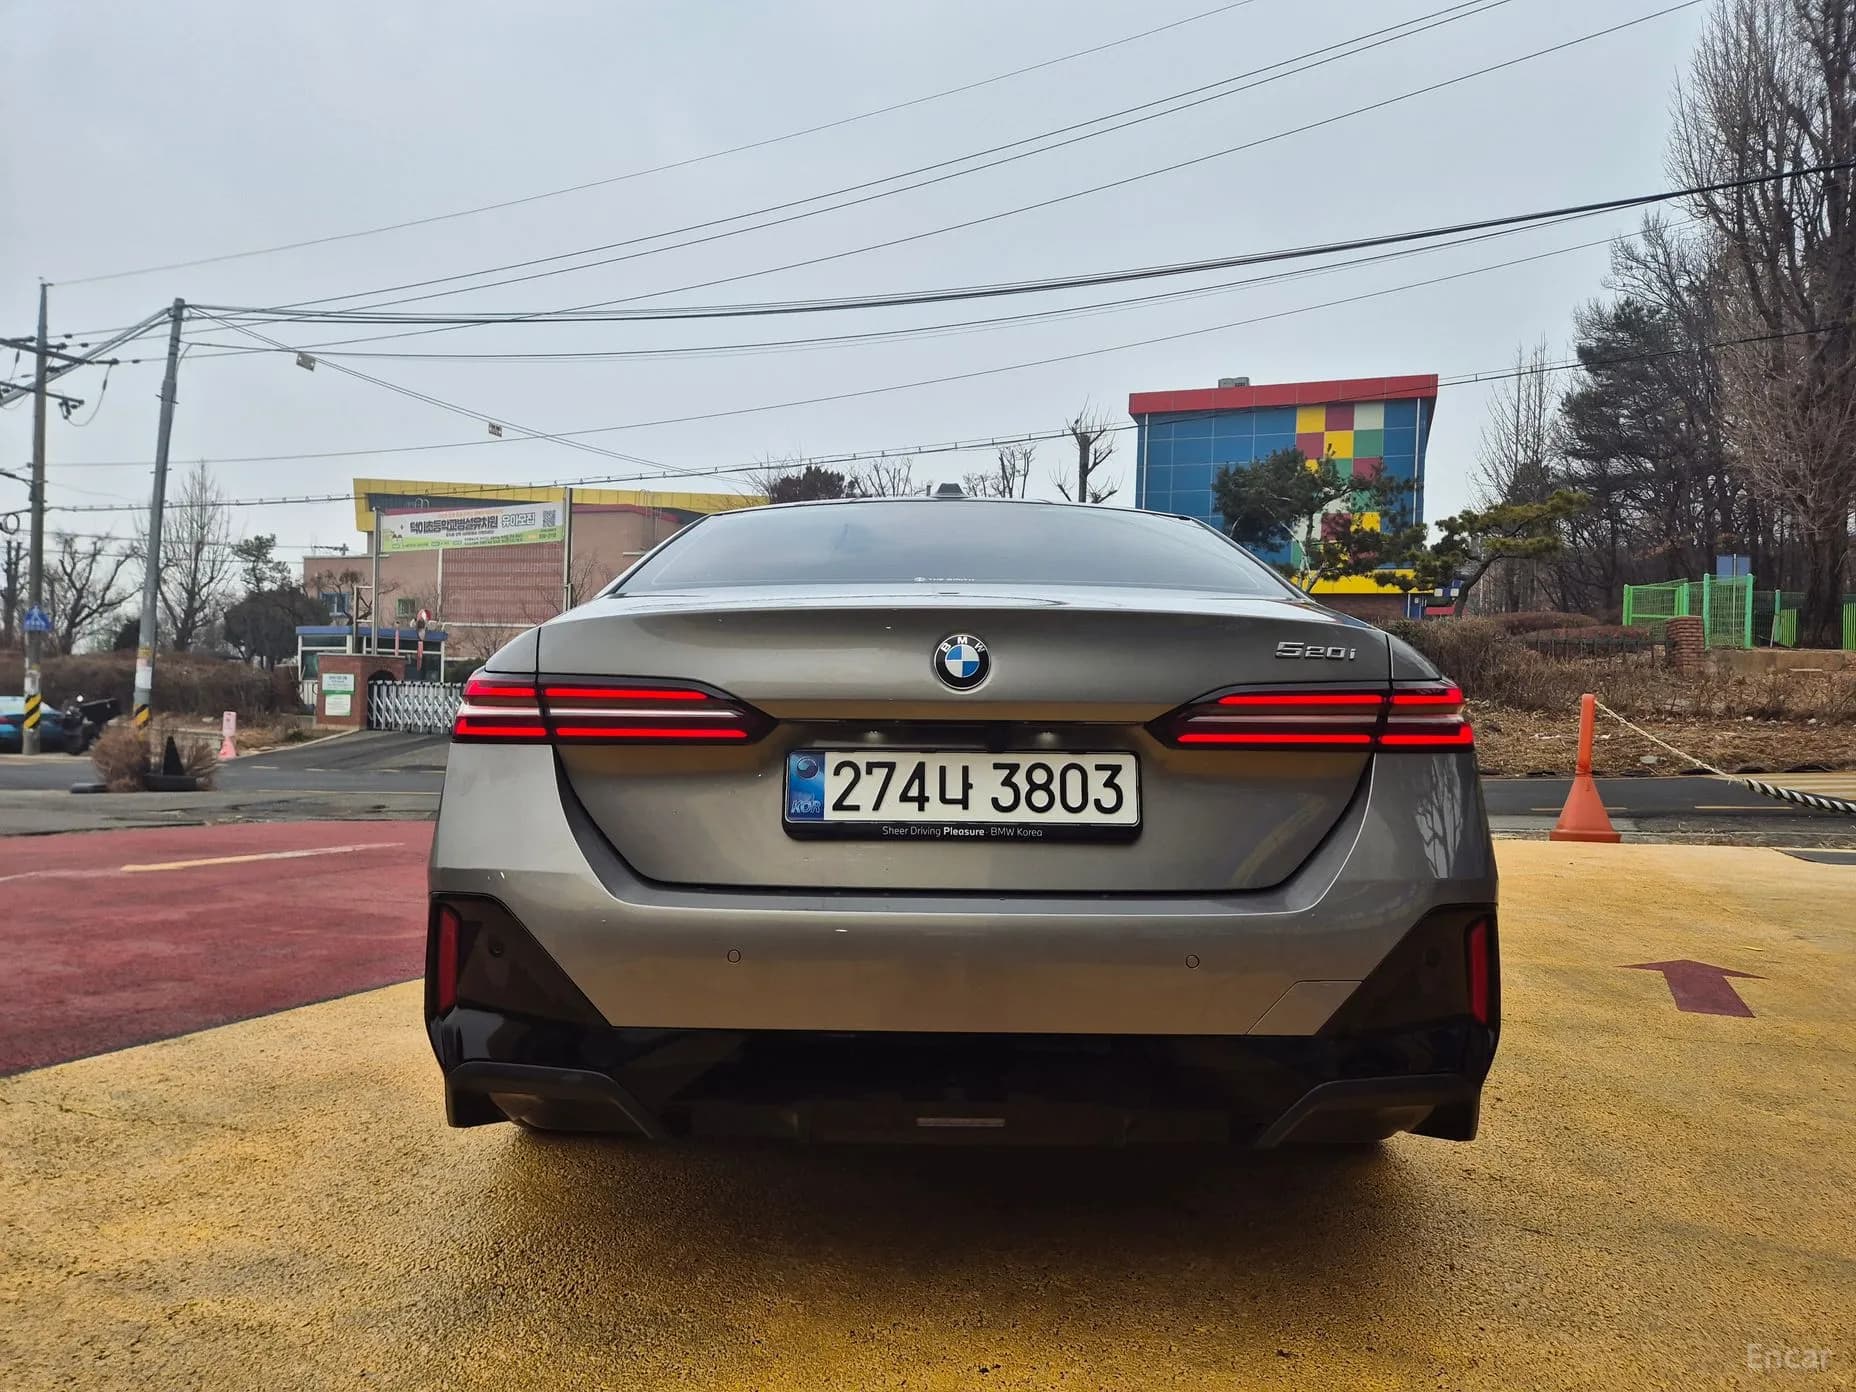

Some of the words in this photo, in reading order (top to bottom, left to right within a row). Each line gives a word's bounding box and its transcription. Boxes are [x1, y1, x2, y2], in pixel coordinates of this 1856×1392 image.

[502, 512, 536, 528] 유아모집
[940, 636, 985, 653] BMW
[1275, 641, 1356, 660] 520i
[831, 760, 974, 812] 274나
[991, 762, 1123, 814] 3803
[791, 796, 822, 813] KOR
[882, 826, 908, 836] Sheer
[910, 826, 941, 838] Driving
[943, 826, 985, 836] Pleasure
[990, 827, 1015, 836] BMW
[1017, 827, 1043, 837] Korea
